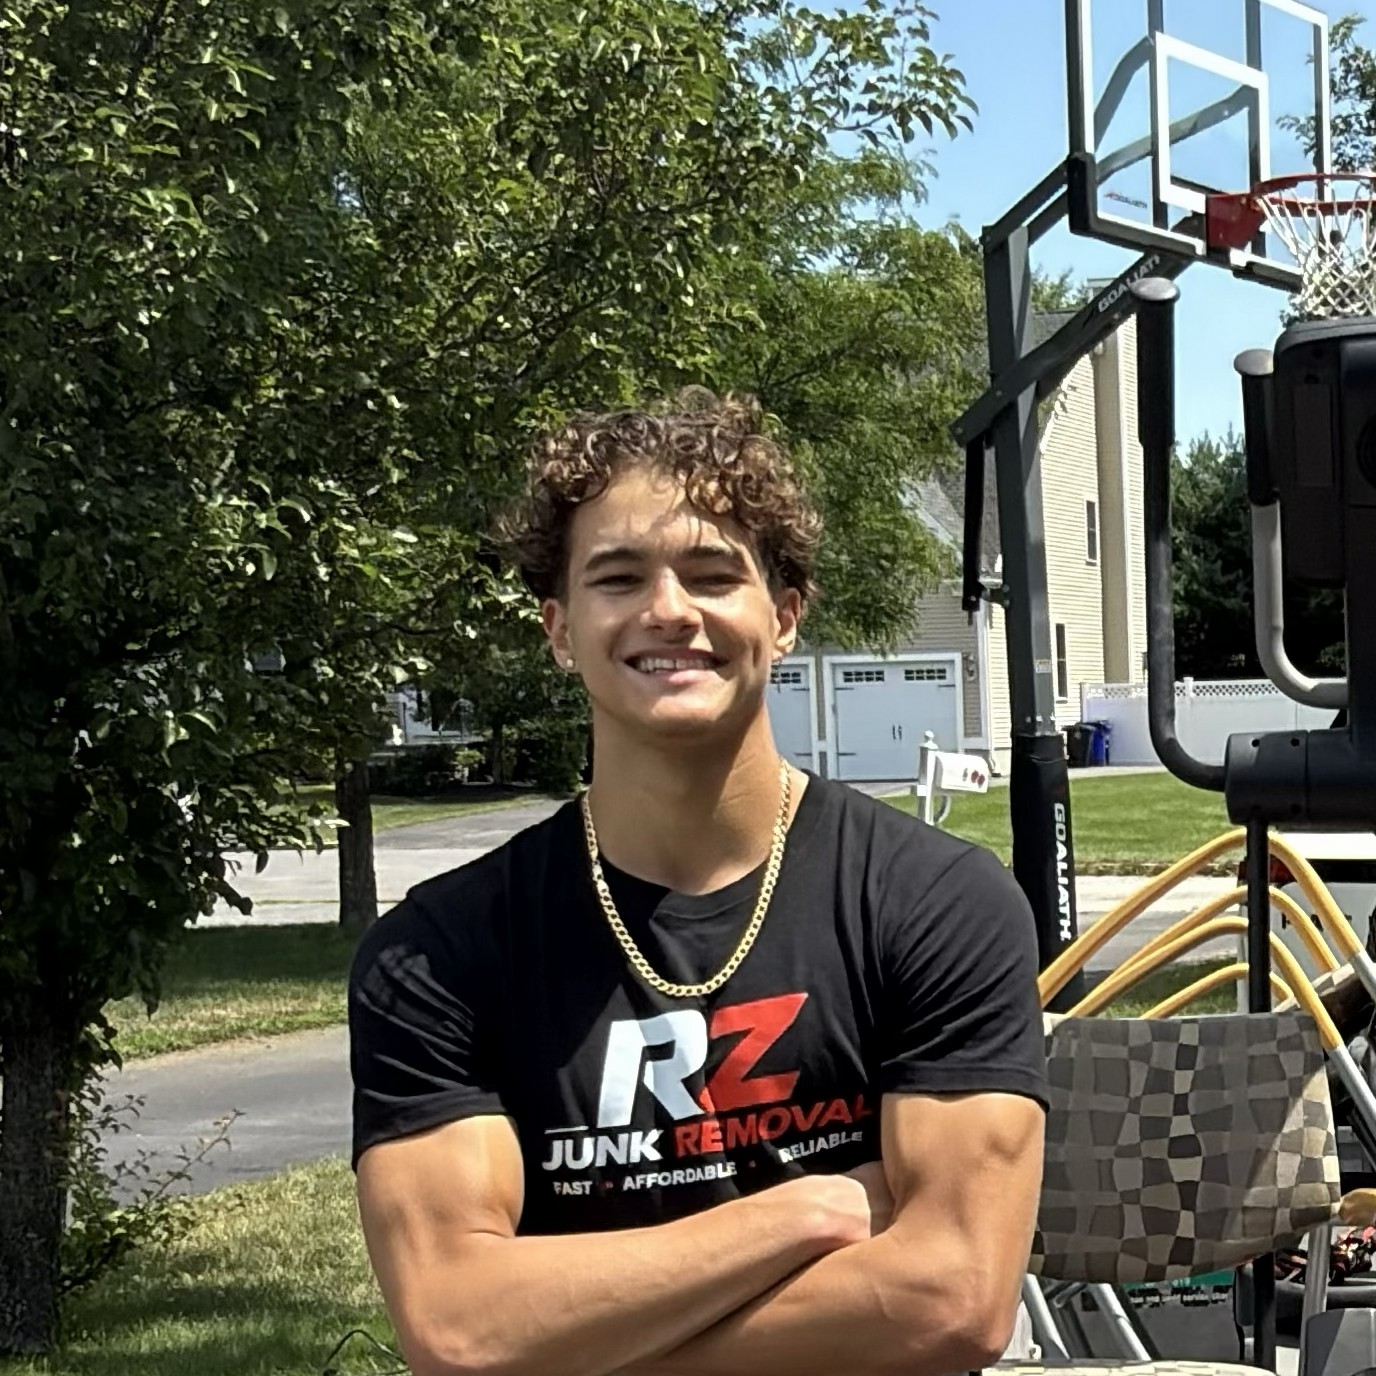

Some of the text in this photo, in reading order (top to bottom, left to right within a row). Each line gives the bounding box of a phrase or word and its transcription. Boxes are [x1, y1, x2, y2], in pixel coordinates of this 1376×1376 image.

[1053, 802, 1073, 941] GOALIATH
[596, 992, 809, 1128] RZ
[541, 1094, 874, 1172] JUNK REMOVAL
[554, 1130, 864, 1195] FAST AFFORDABLE RELIABLE
